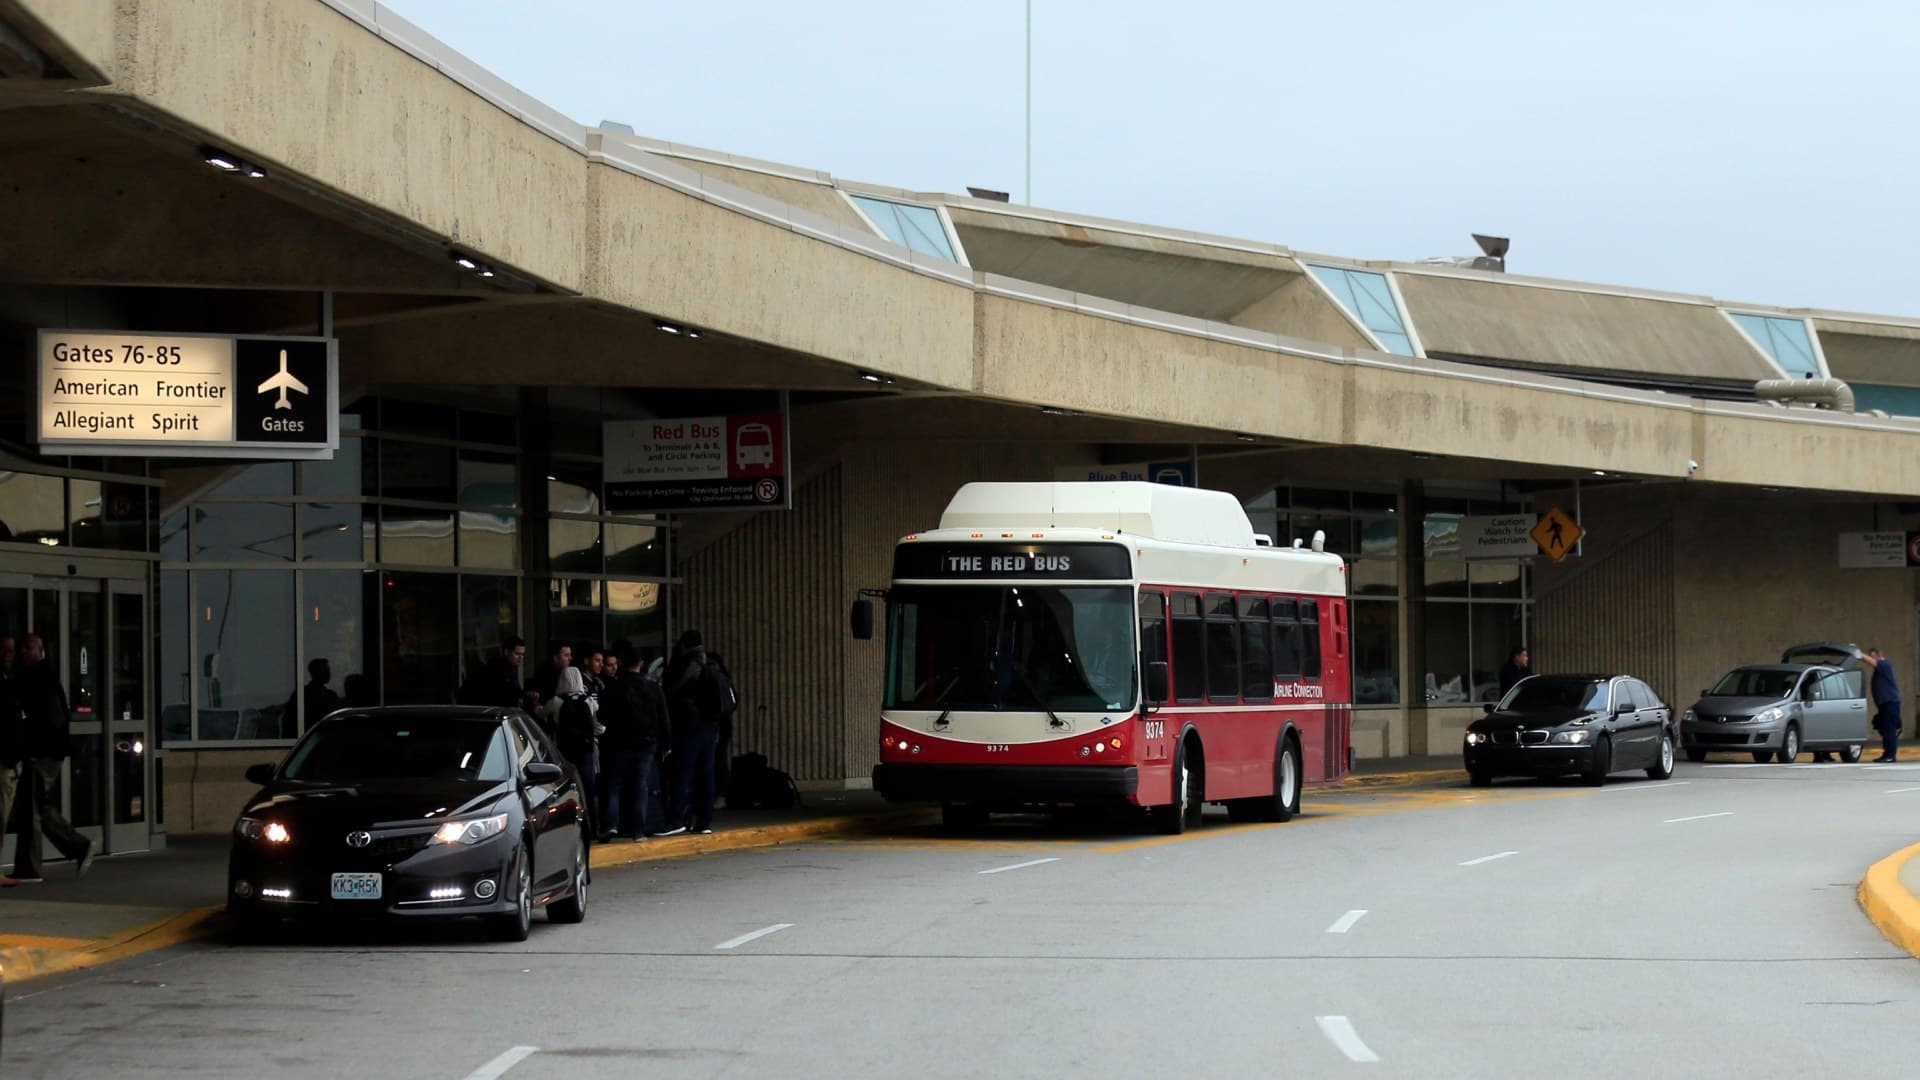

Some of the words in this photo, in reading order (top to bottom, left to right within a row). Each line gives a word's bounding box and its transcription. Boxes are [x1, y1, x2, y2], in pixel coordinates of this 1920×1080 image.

[53, 343, 113, 363] Gates
[121, 345, 181, 365] 76-85
[53, 378, 139, 396] American
[156, 381, 226, 399] Frontier
[53, 411, 135, 433] Allegiant
[152, 413, 199, 434] Spirit
[261, 417, 304, 432] Gates
[653, 424, 683, 440] Red
[691, 423, 720, 439] Bus
[643, 444, 652, 452] To
[655, 443, 691, 452] Terminals
[694, 442, 701, 450] A
[648, 453, 663, 461] and
[665, 452, 687, 460] Circle
[690, 452, 720, 461] Parking
[1088, 471, 1117, 481] Blue
[1120, 471, 1144, 481] Bus
[625, 488, 653, 498] Parking
[654, 488, 685, 497] Anytime
[692, 487, 718, 495] Towing
[720, 485, 753, 493] Enforced
[1491, 518, 1526, 527] Caution
[1485, 526, 1511, 536] Watch
[1514, 526, 1527, 535] for
[1478, 536, 1527, 545] Pedestrians
[949, 556, 982, 571] THE
[991, 556, 1026, 571] RED
[1034, 556, 1070, 571] BUS
[1145, 721, 1164, 739] 9374
[987, 744, 1009, 752] 9374
